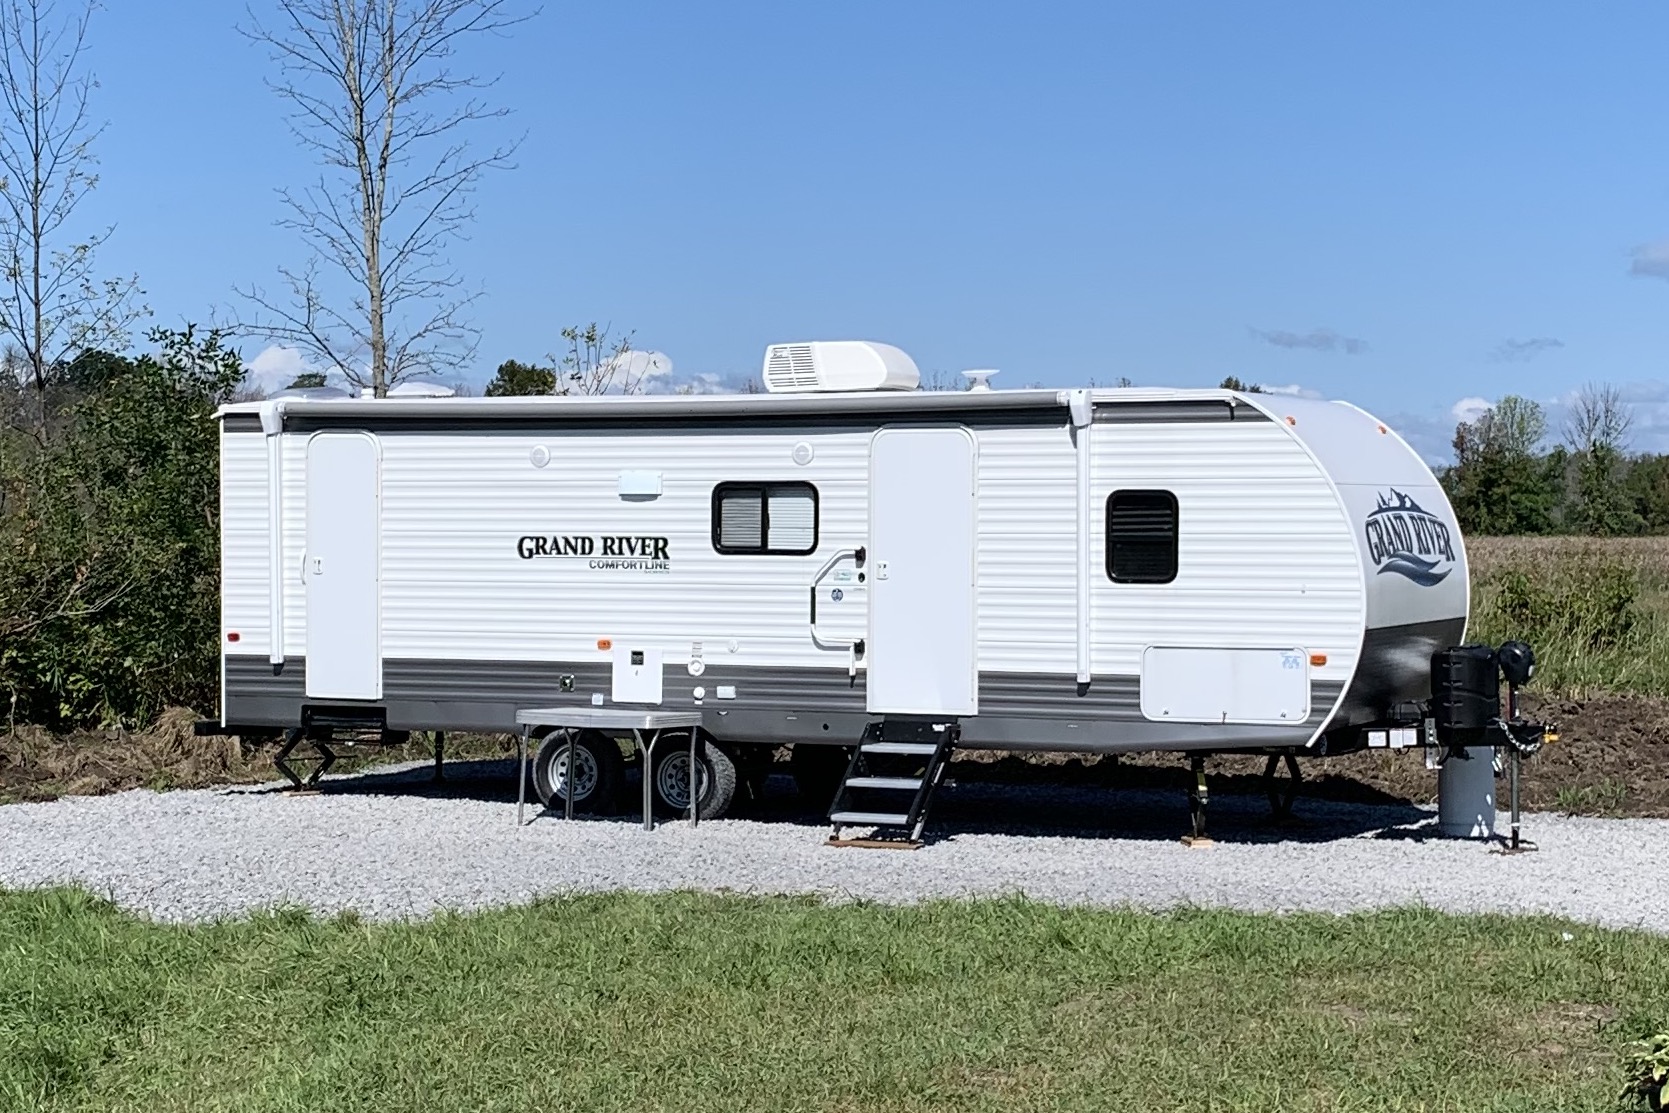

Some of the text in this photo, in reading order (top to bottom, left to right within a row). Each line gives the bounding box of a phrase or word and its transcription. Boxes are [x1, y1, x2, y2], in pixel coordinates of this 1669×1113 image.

[517, 536, 670, 560] GRAND RIVER
[1365, 512, 1456, 566] GRAND RIVER
[589, 560, 670, 570] COMFORTLINE
